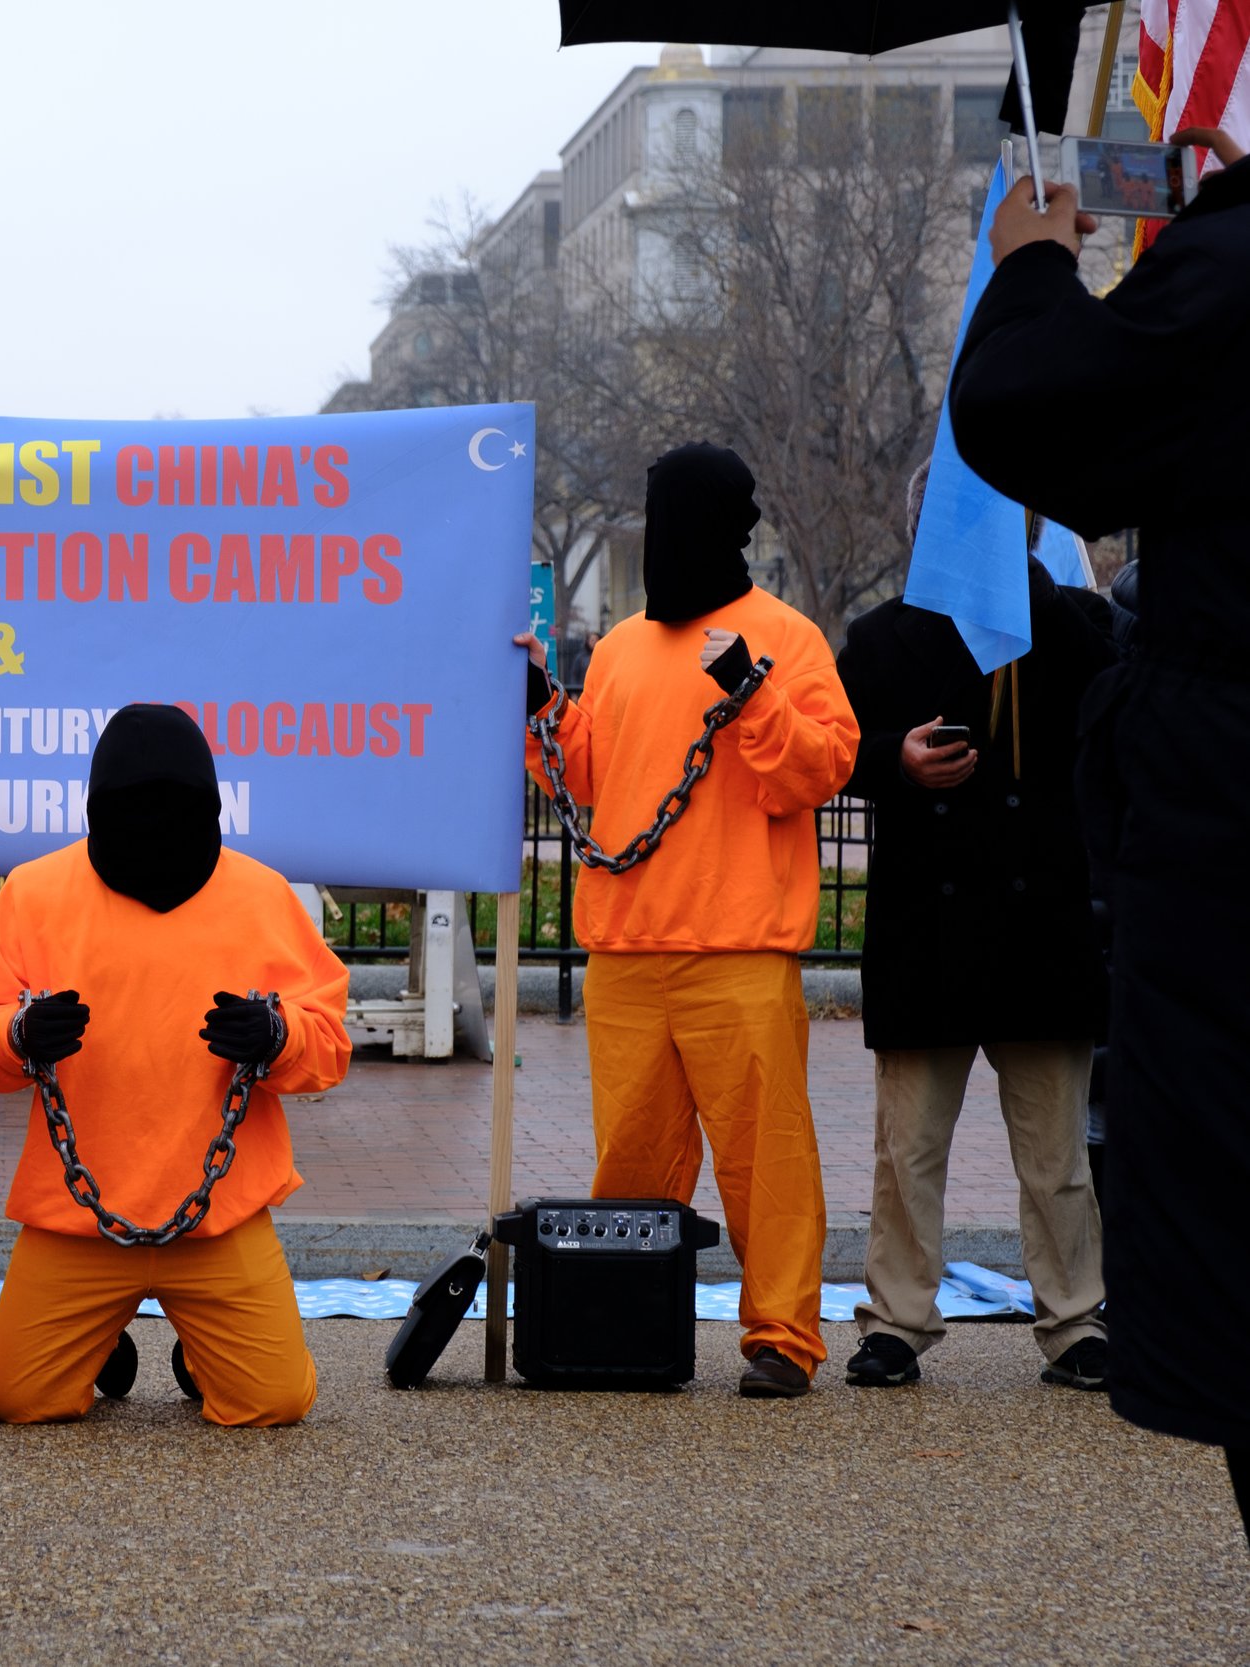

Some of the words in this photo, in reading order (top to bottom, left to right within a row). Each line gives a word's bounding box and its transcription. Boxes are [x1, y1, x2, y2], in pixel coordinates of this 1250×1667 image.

[116, 445, 350, 508] CHINA'S
[169, 533, 403, 605] CAMPS
[131, 701, 432, 757] LOCAUST
[557, 1240, 580, 1248] ALTO
